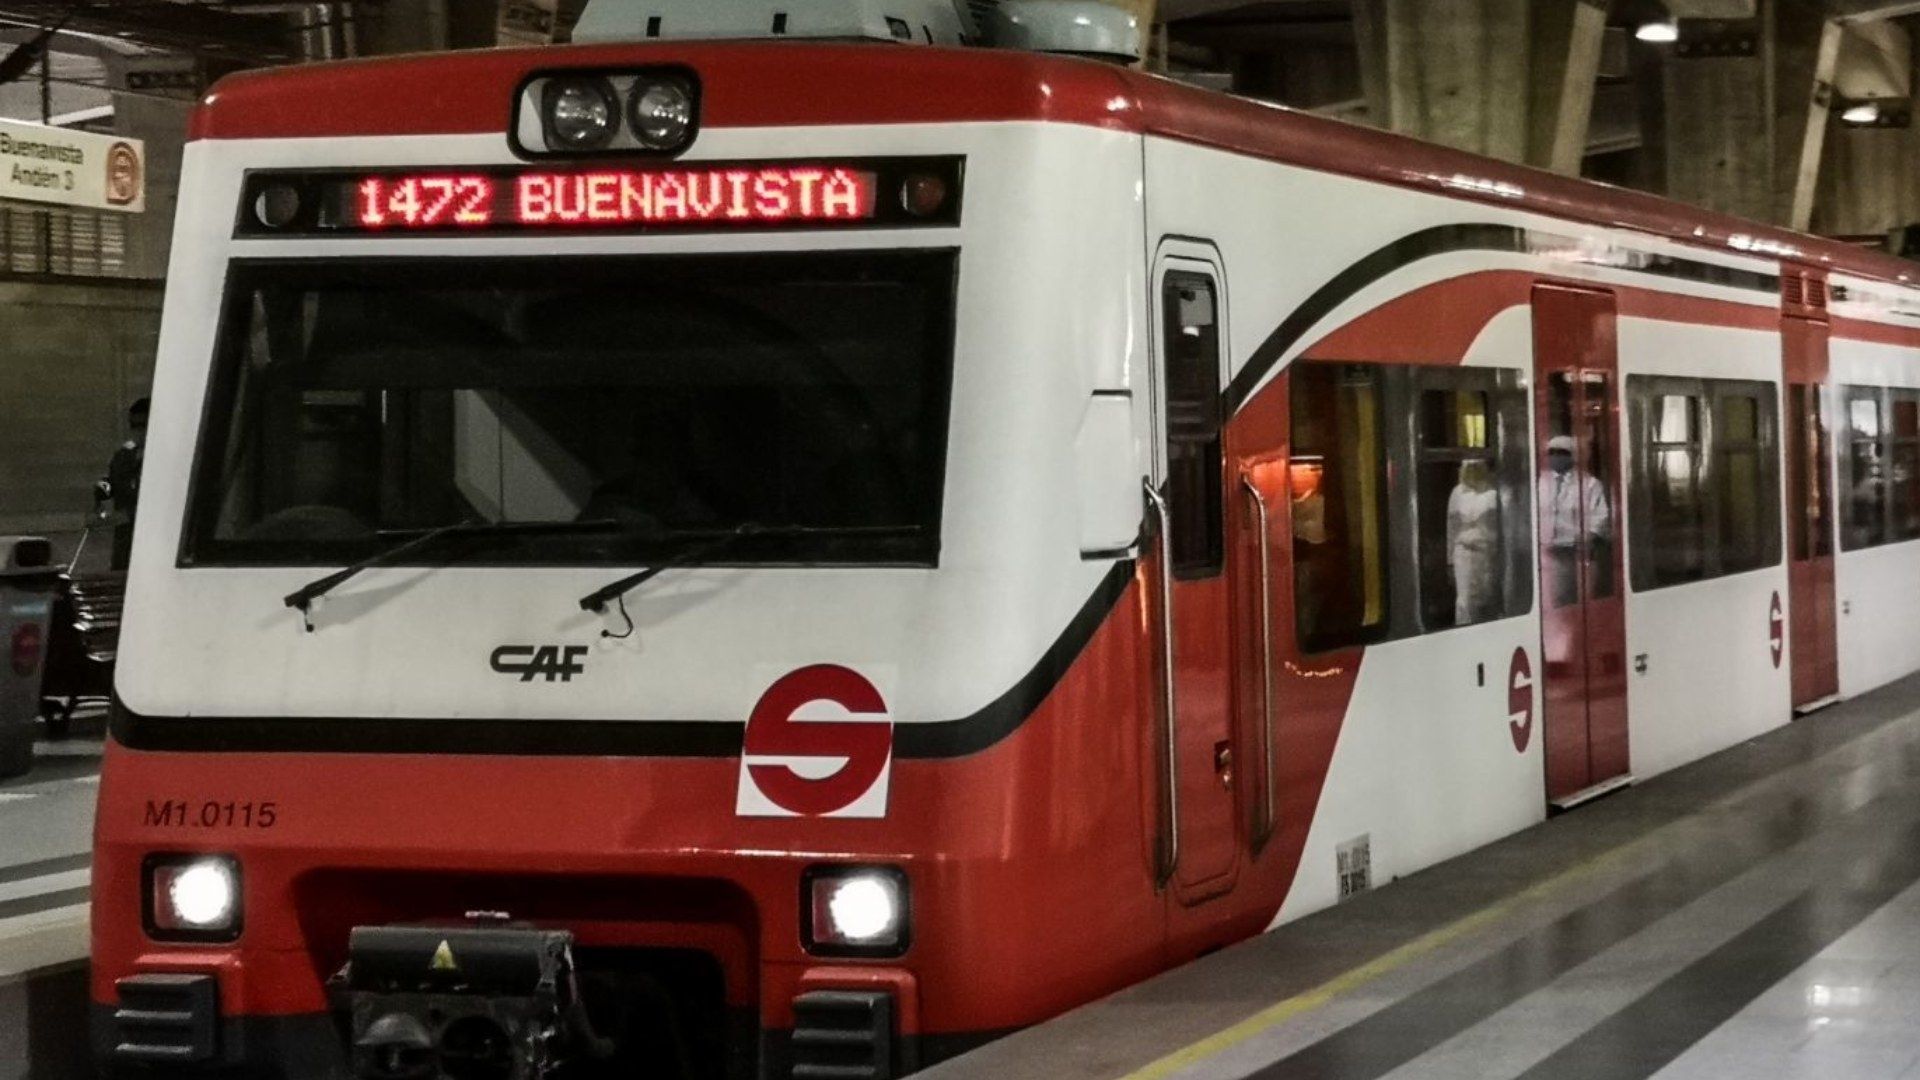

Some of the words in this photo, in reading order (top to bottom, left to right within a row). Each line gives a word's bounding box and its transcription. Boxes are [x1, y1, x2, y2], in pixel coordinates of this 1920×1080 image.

[360, 177, 491, 226] 1472
[517, 168, 861, 223] BUENAVISTA
[489, 645, 588, 682] CAF
[744, 663, 893, 817] S
[143, 800, 277, 828] M1.0115
